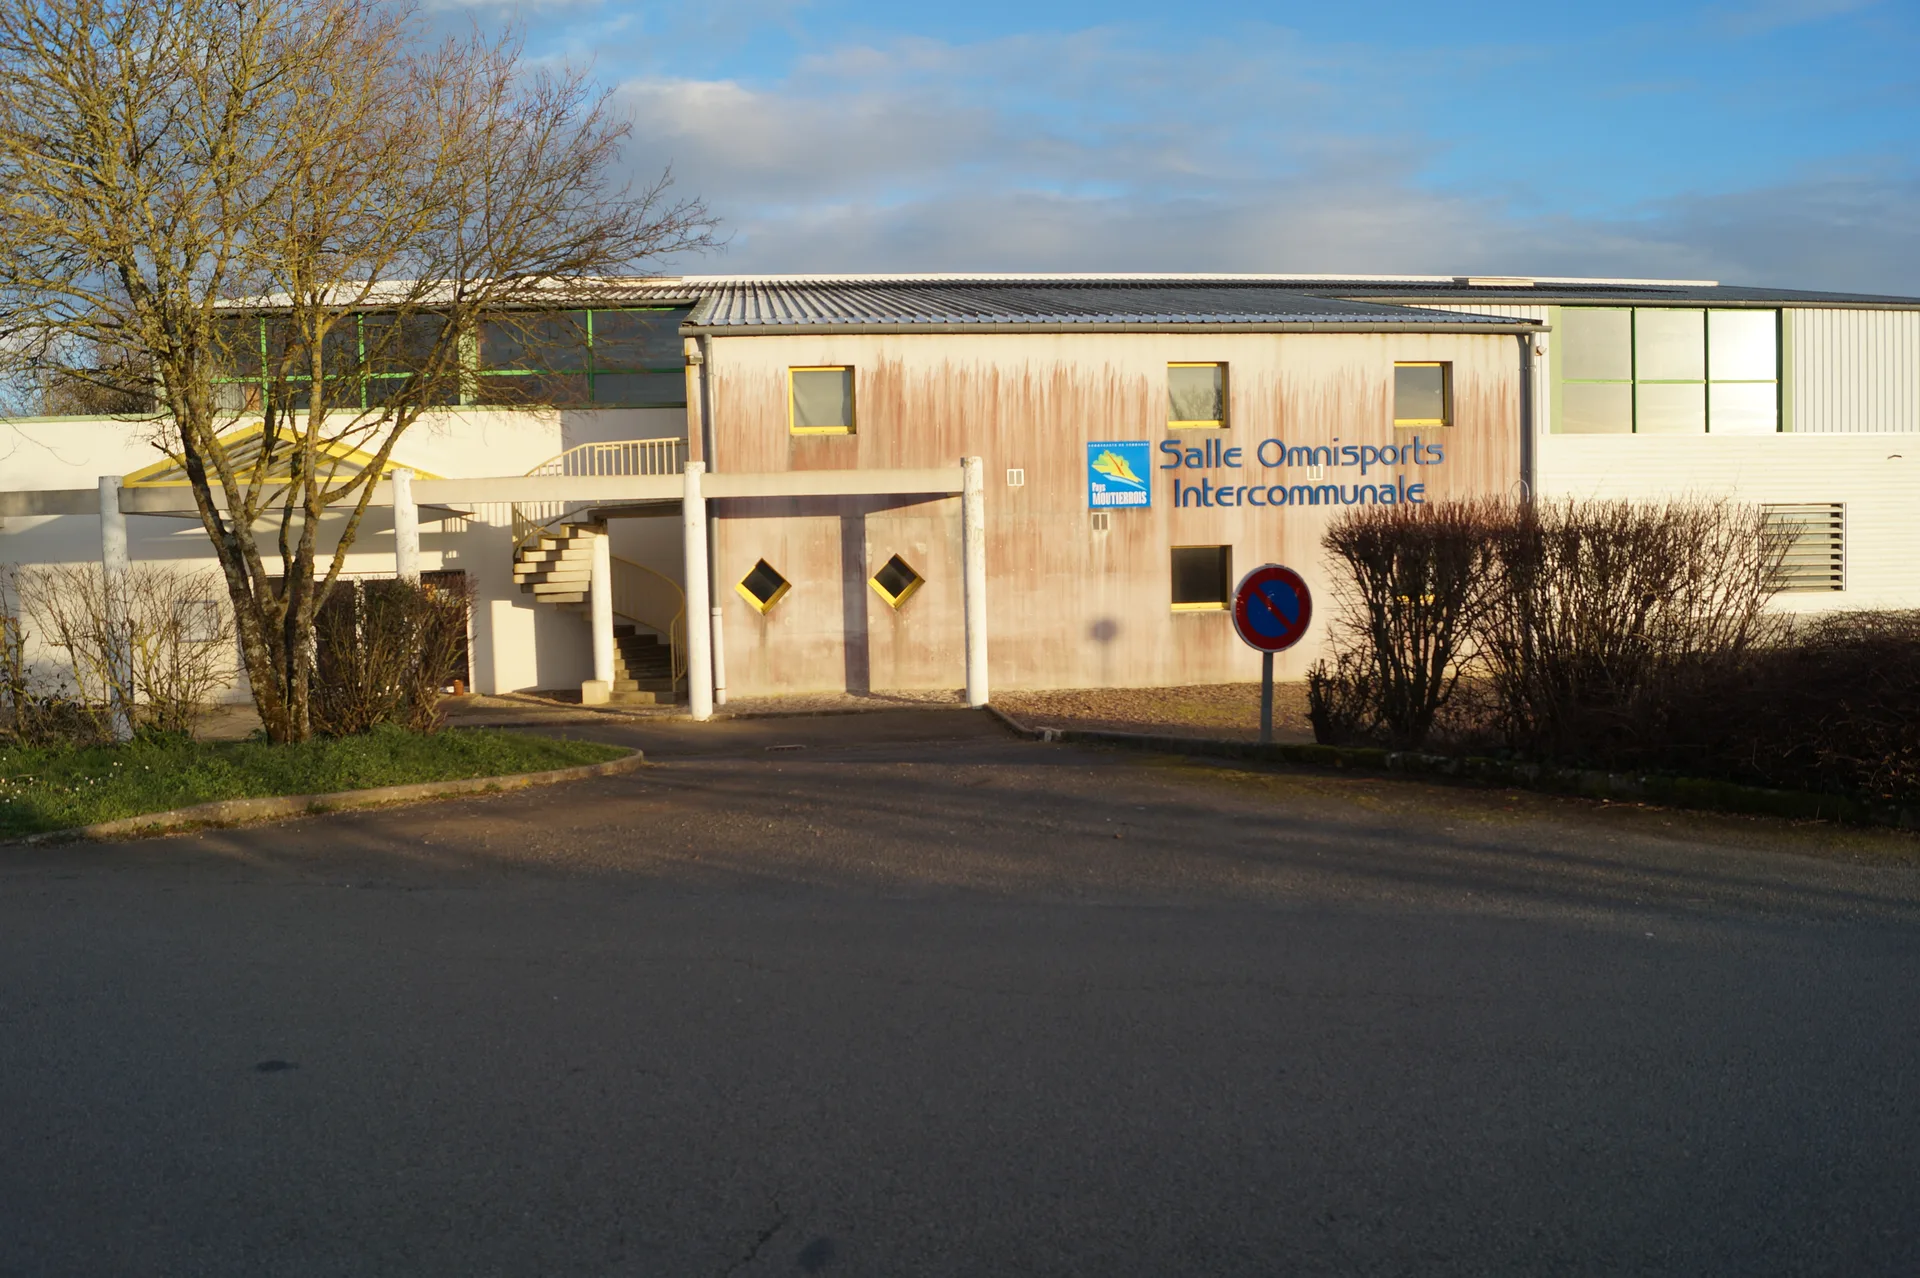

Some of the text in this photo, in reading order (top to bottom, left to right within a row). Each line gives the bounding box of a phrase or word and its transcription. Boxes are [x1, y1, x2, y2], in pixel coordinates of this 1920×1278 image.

[1159, 435, 1445, 476] Salle Omnisports
[1174, 475, 1425, 508] Intercommunale
